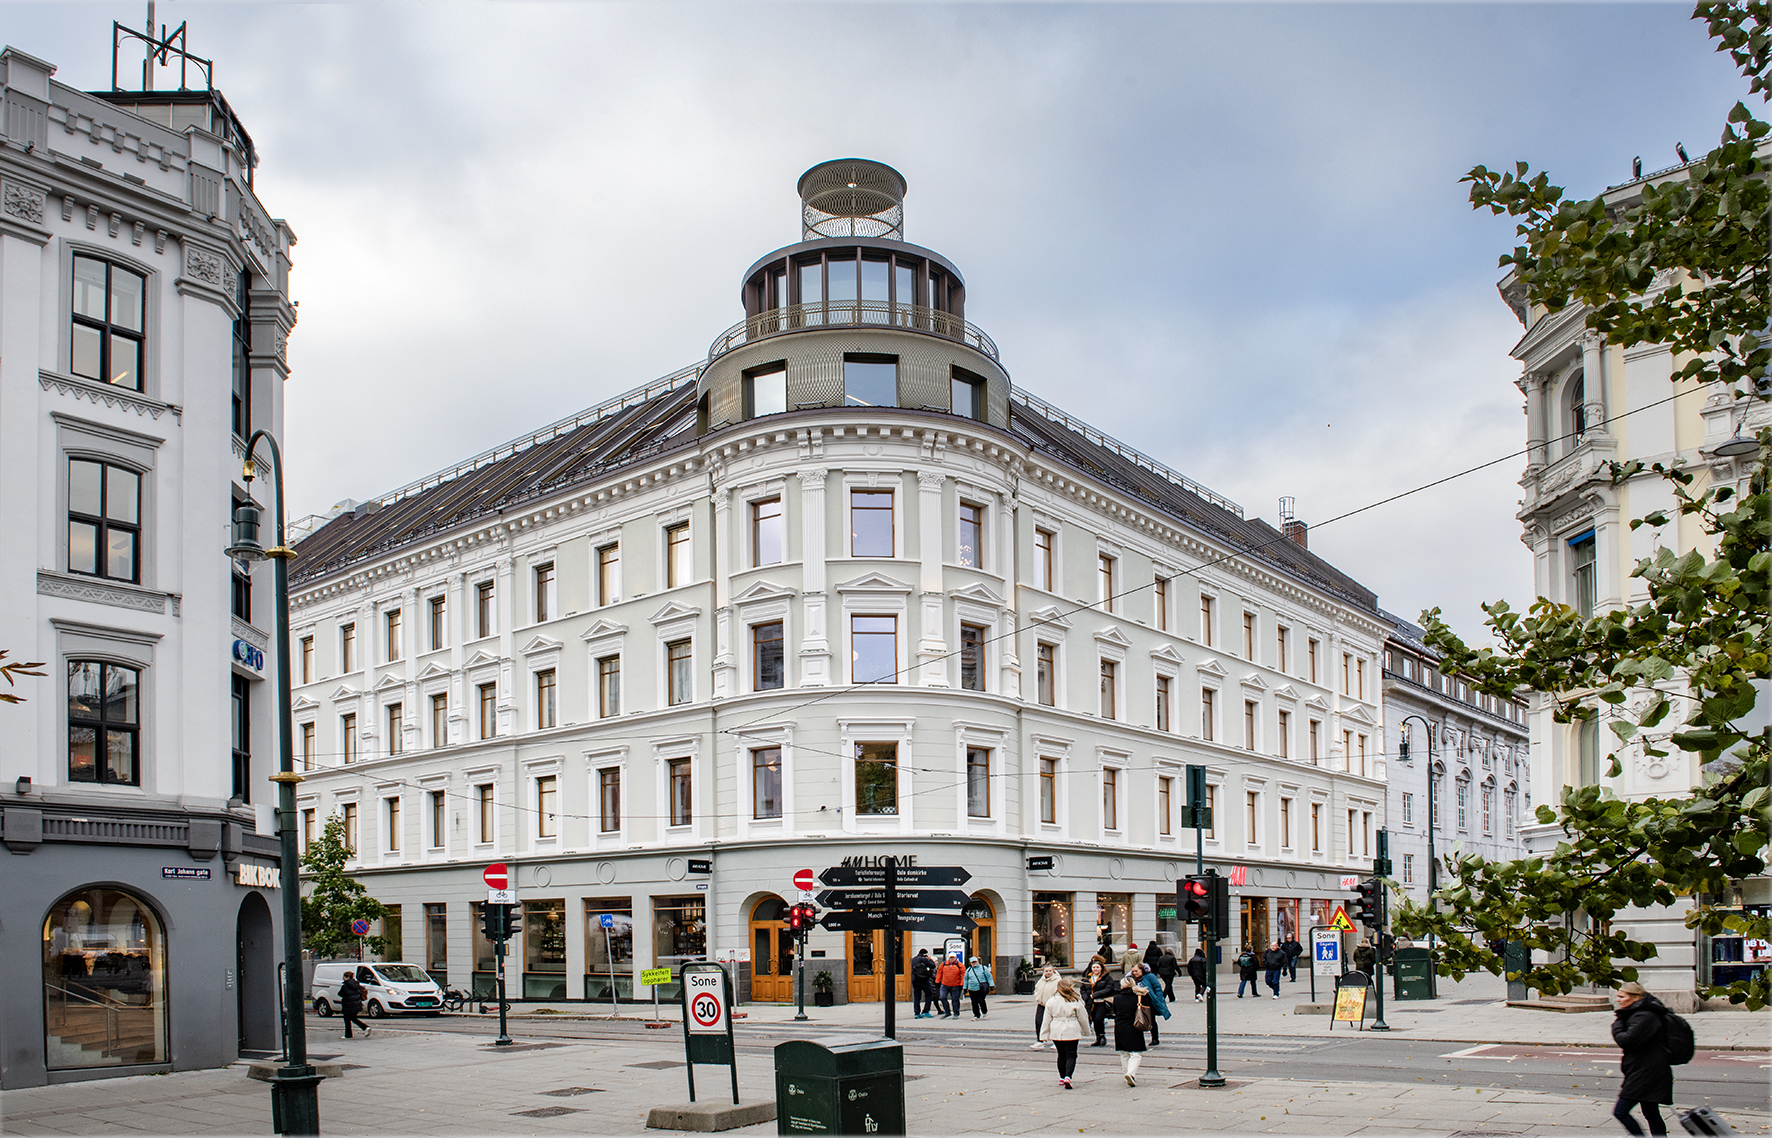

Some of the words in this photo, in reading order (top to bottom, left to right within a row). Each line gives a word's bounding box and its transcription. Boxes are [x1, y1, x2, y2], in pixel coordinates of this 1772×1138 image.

[239, 863, 259, 886] BIK
[259, 866, 282, 888] BOK
[642, 970, 670, 978] Sykkelfelt
[691, 976, 717, 987] Sone
[697, 1002, 716, 1018] 30
